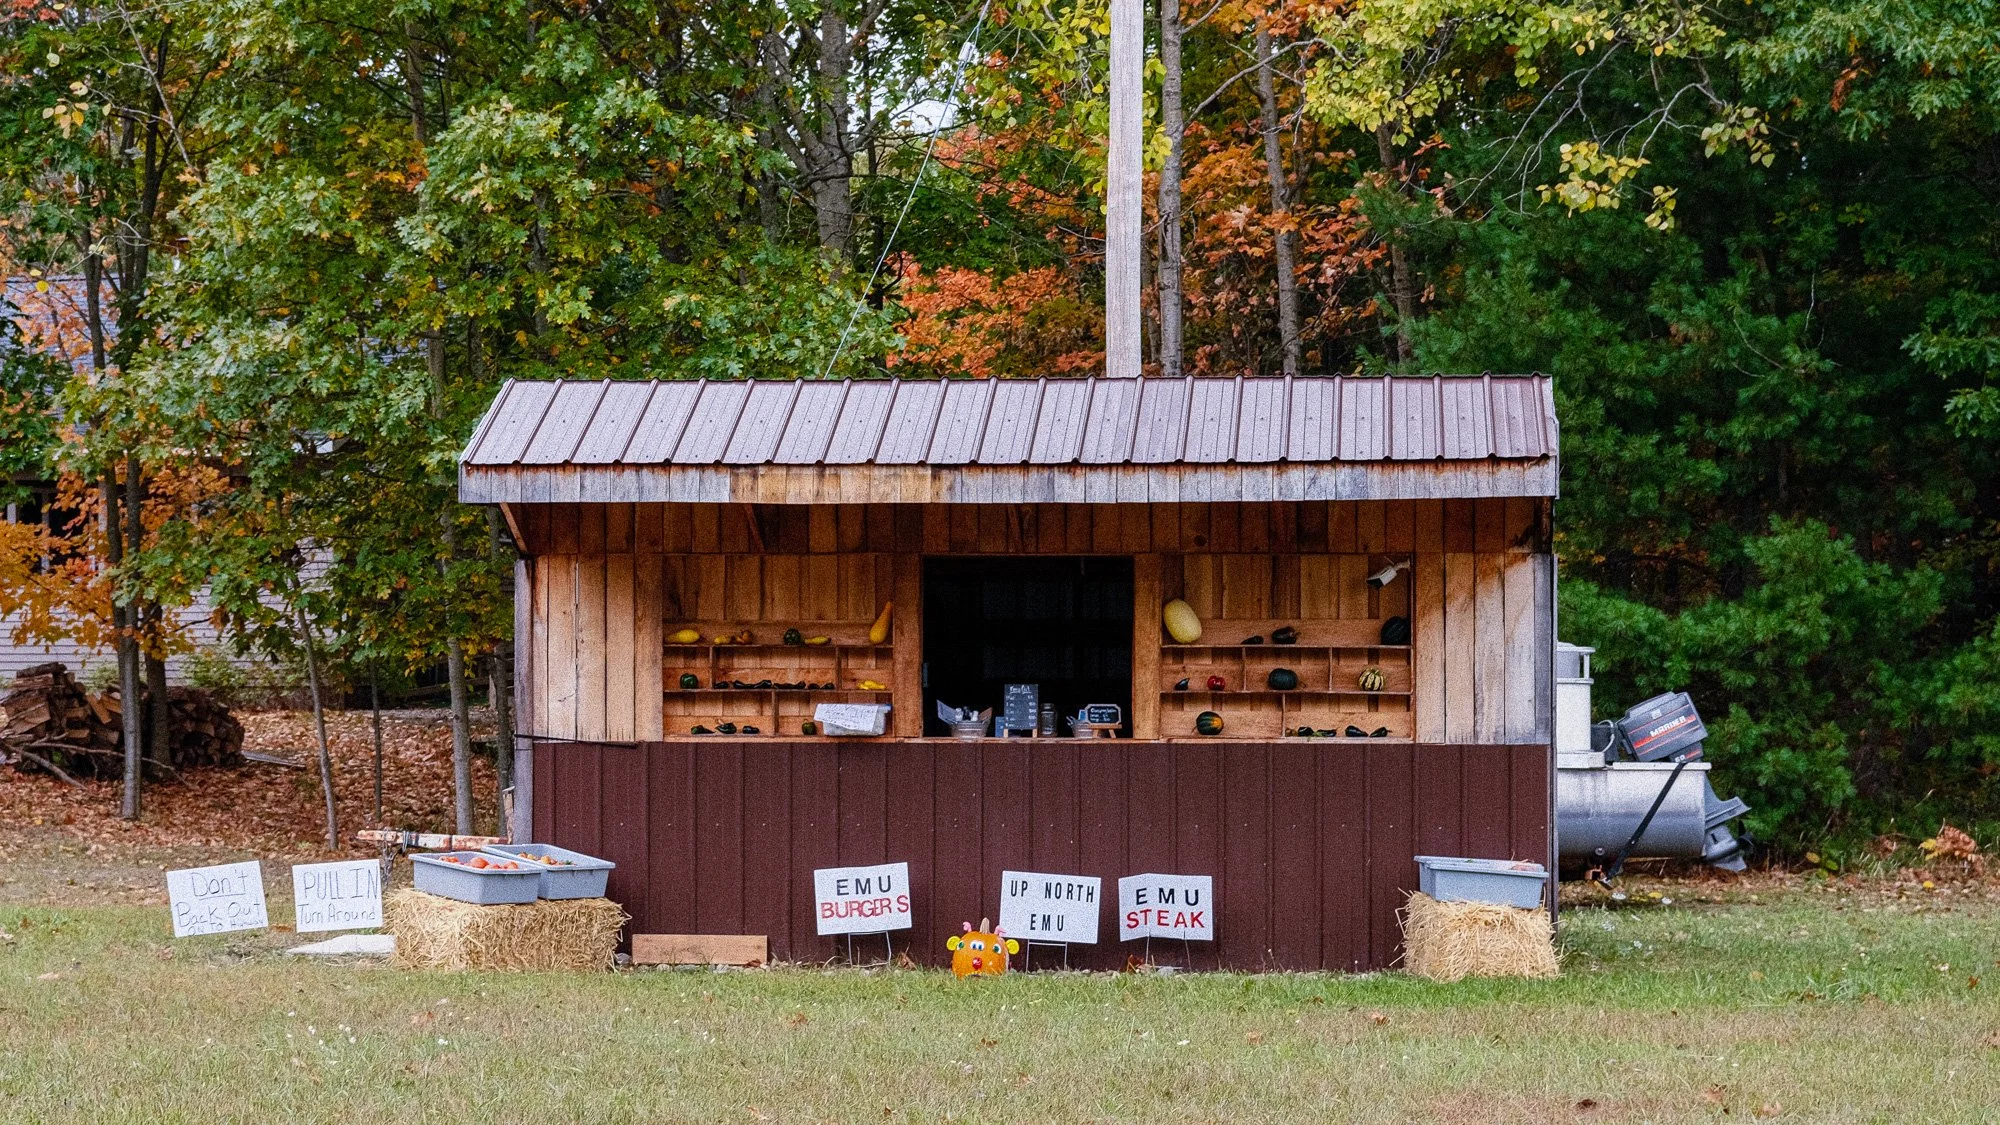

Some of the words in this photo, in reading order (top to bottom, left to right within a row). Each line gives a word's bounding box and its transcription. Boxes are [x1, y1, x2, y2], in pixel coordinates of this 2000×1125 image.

[1650, 716, 1686, 737] MARINER
[190, 868, 248, 896] Don't
[303, 871, 344, 900] PULL
[349, 865, 379, 900] IN
[836, 875, 892, 896] EMU
[1010, 879, 1028, 898] UP
[1044, 882, 1095, 903] NORTH
[1135, 887, 1200, 907] EMU
[175, 902, 222, 928] Back
[227, 897, 261, 917] Out
[297, 904, 324, 925] Turn
[328, 902, 376, 923] Around
[1030, 913, 1065, 932] EMU
[1126, 908, 1205, 929] STEAK
